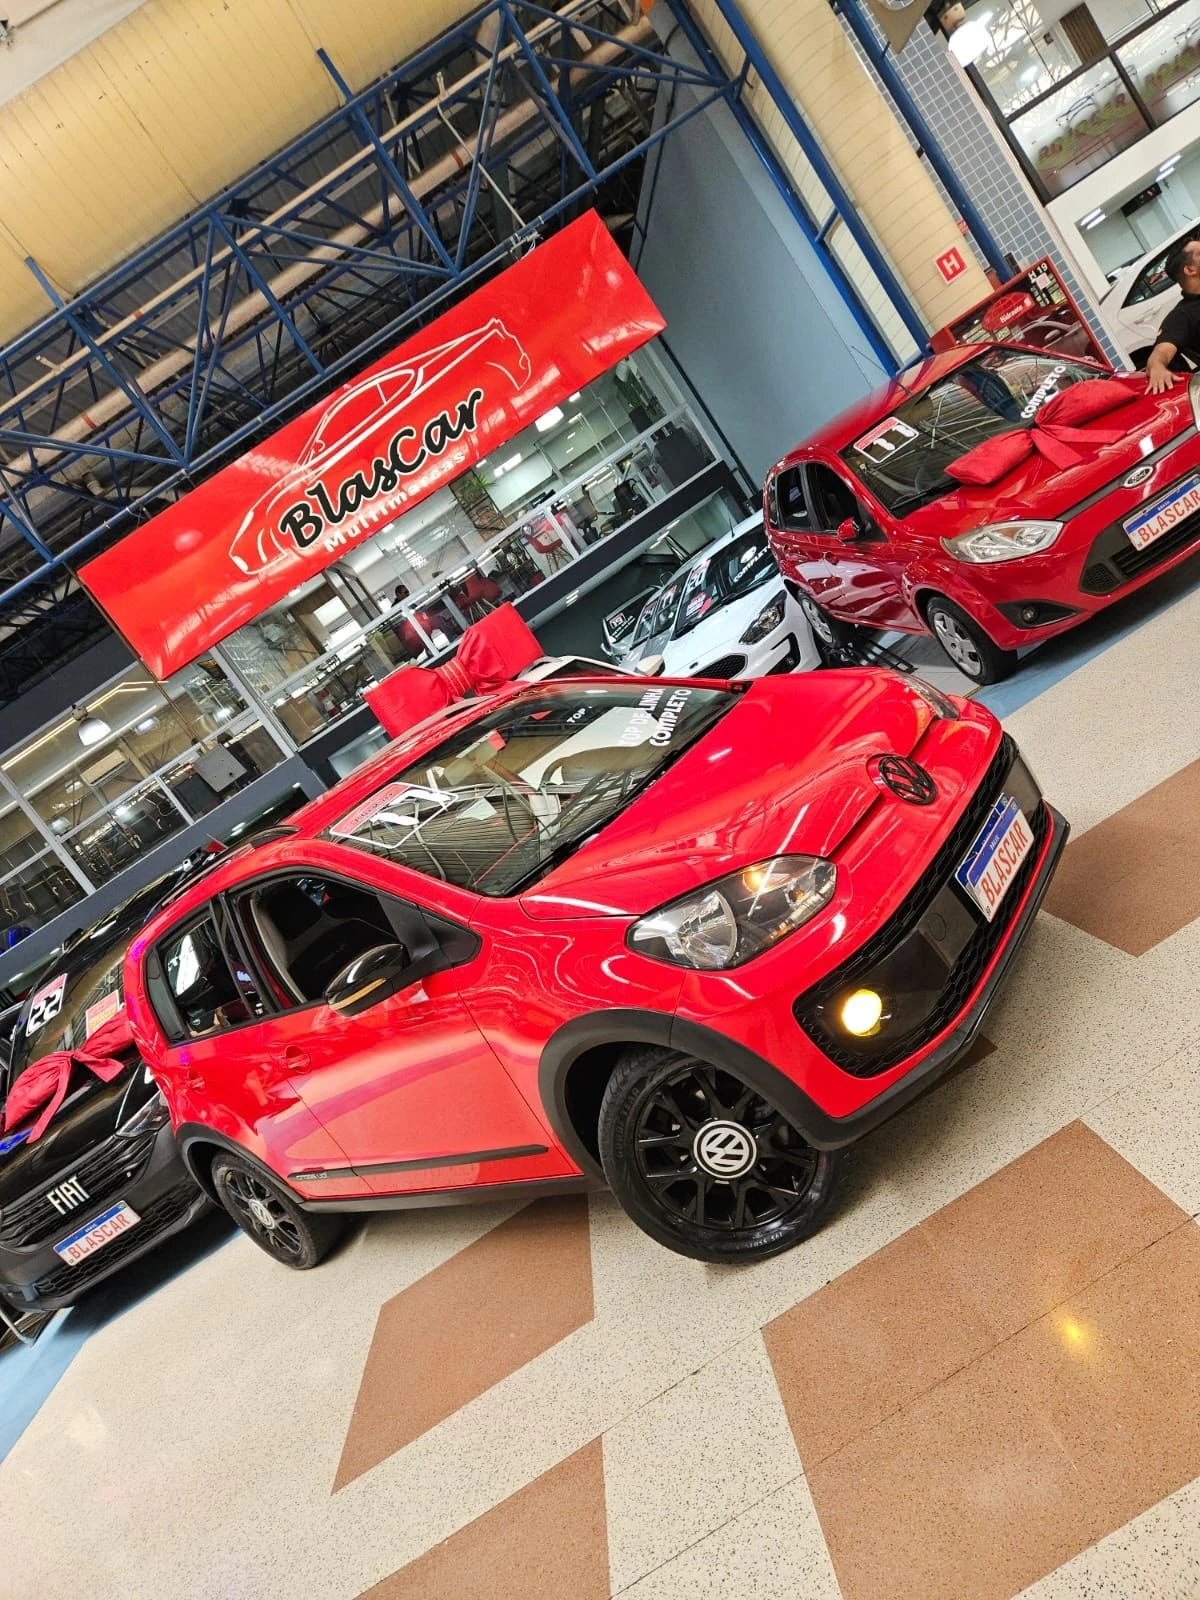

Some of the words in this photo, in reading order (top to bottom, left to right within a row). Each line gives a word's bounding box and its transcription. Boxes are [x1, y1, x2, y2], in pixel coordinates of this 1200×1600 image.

[943, 254, 961, 275] H
[1027, 270, 1039, 283] H
[1037, 262, 1049, 275] 19
[1020, 365, 1067, 419] COMPLETO
[279, 388, 484, 549] BlasCar
[323, 449, 467, 554] Multimarcas
[1137, 489, 1200, 543] BLASCAR
[639, 688, 666, 712] LINHA
[648, 688, 693, 747] COMPLETO
[980, 819, 1029, 908] BLASCAR
[29, 988, 63, 1034] 22
[46, 1175, 91, 1216] FIAT
[68, 1213, 131, 1261] BLASCAR
